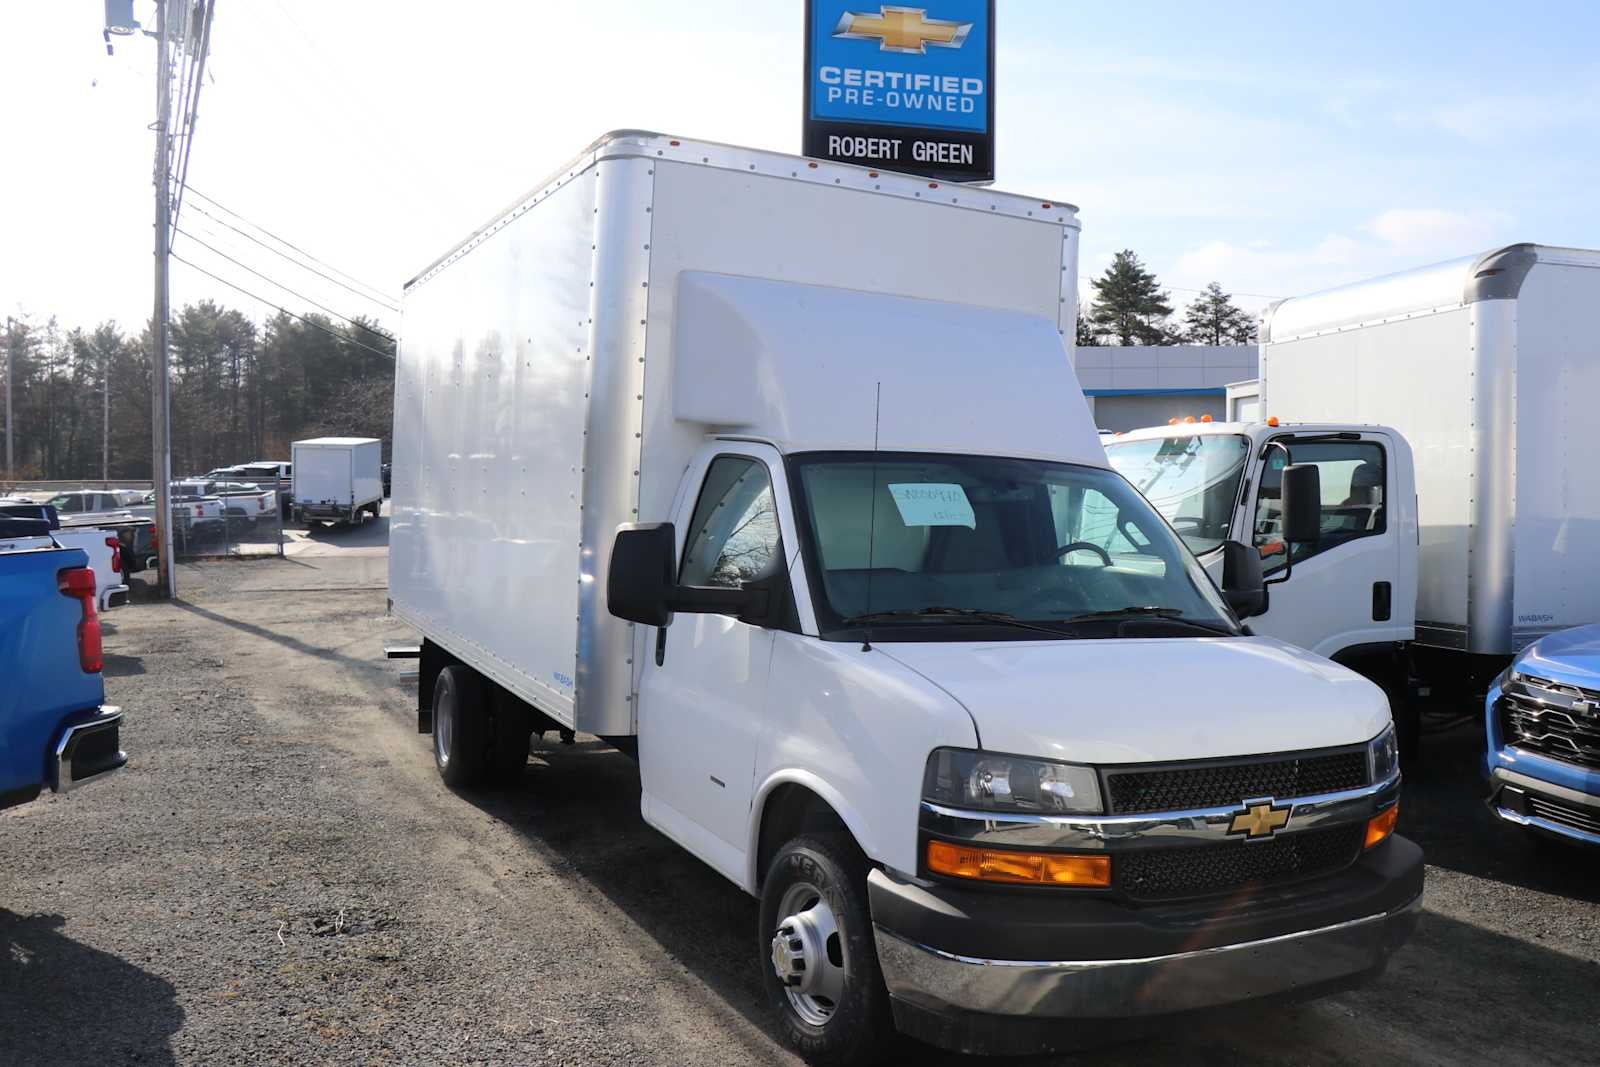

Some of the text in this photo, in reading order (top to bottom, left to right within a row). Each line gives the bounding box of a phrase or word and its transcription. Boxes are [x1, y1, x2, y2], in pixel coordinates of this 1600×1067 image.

[820, 66, 984, 96] CERTIFIED
[828, 87, 974, 113] PRE-OWNED
[828, 135, 973, 164] ROBERT GREEN
